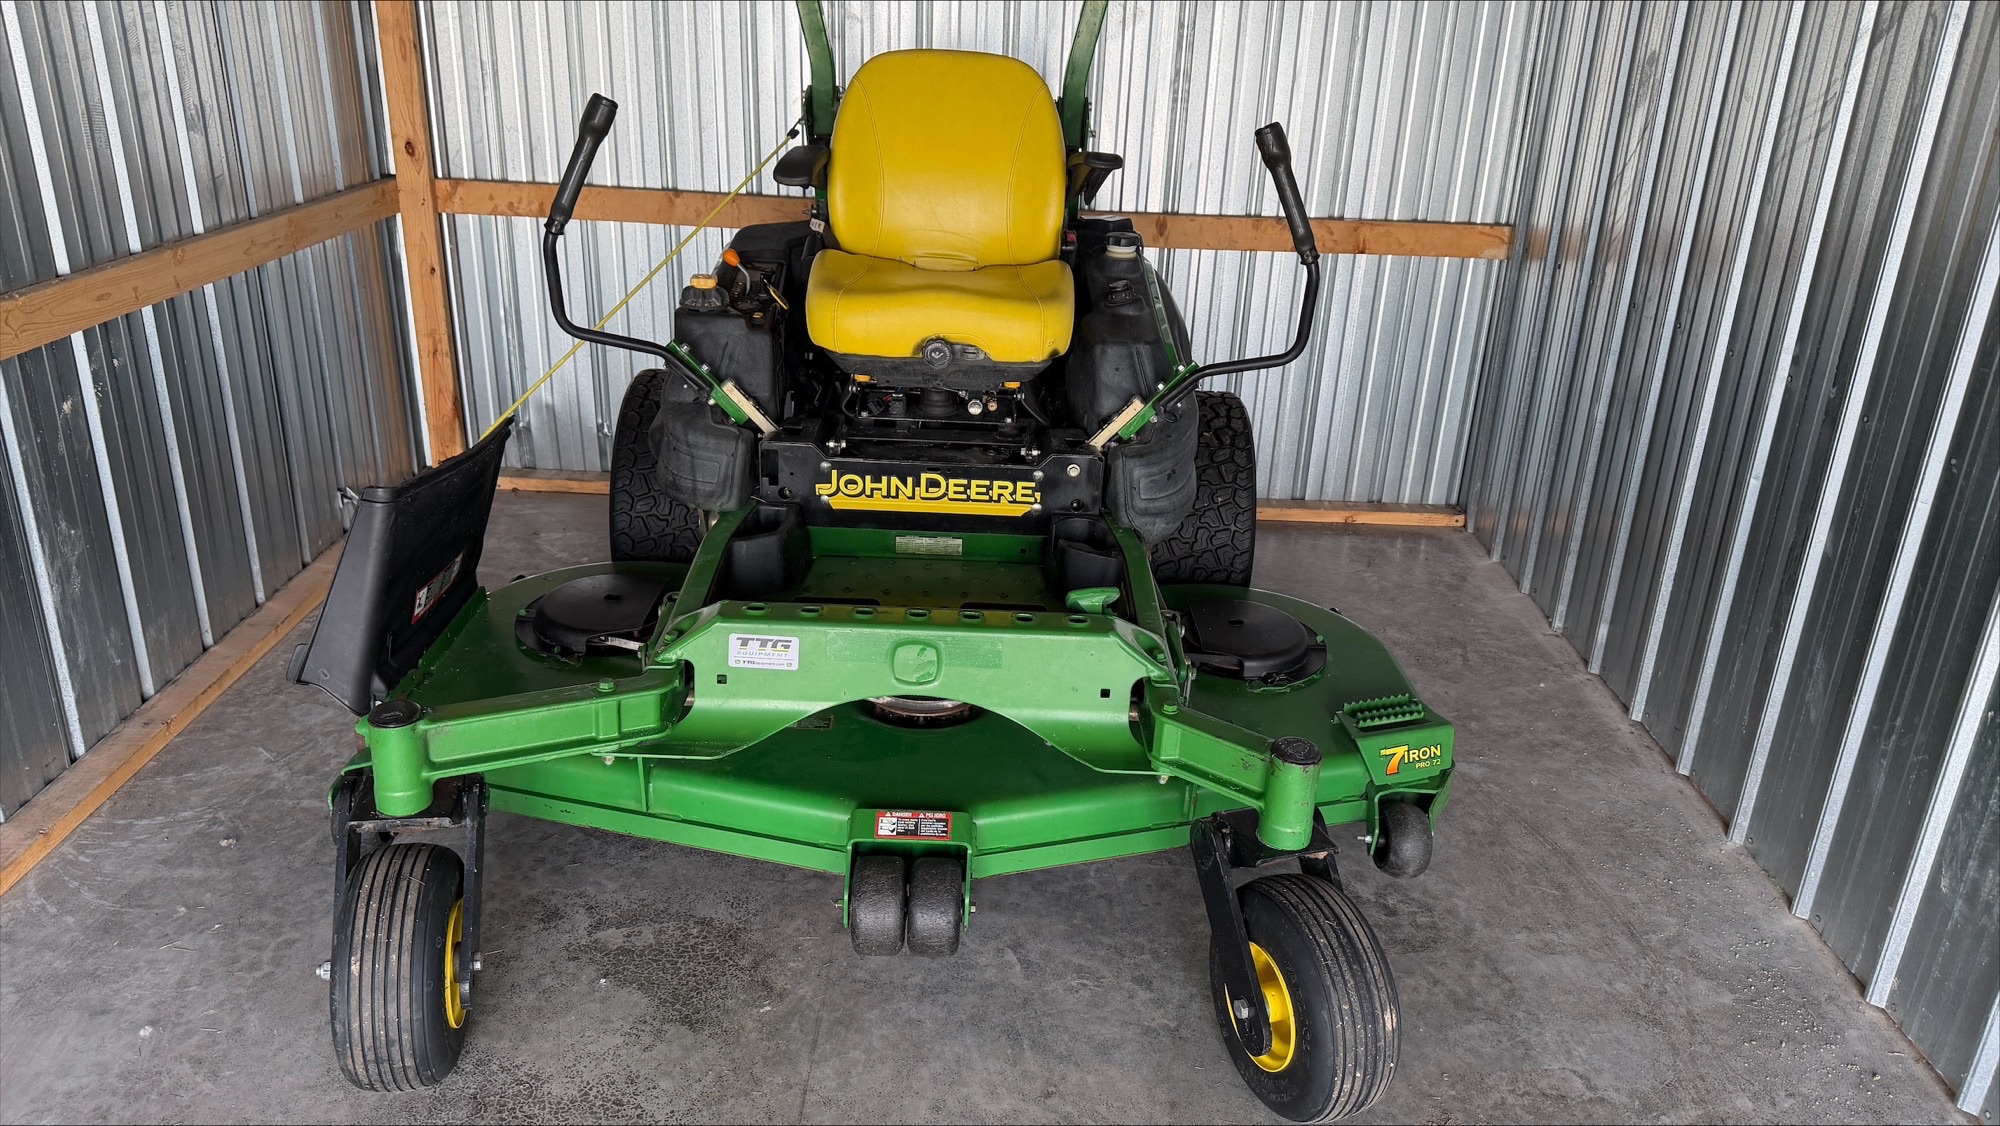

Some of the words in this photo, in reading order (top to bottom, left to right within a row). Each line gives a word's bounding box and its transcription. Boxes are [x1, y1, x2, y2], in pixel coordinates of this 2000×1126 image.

[817, 469, 913, 499] JOHN
[920, 472, 1037, 503] DEERE
[736, 637, 792, 652] TTG
[1415, 761, 1431, 769] PRO
[1433, 758, 1441, 766] 72
